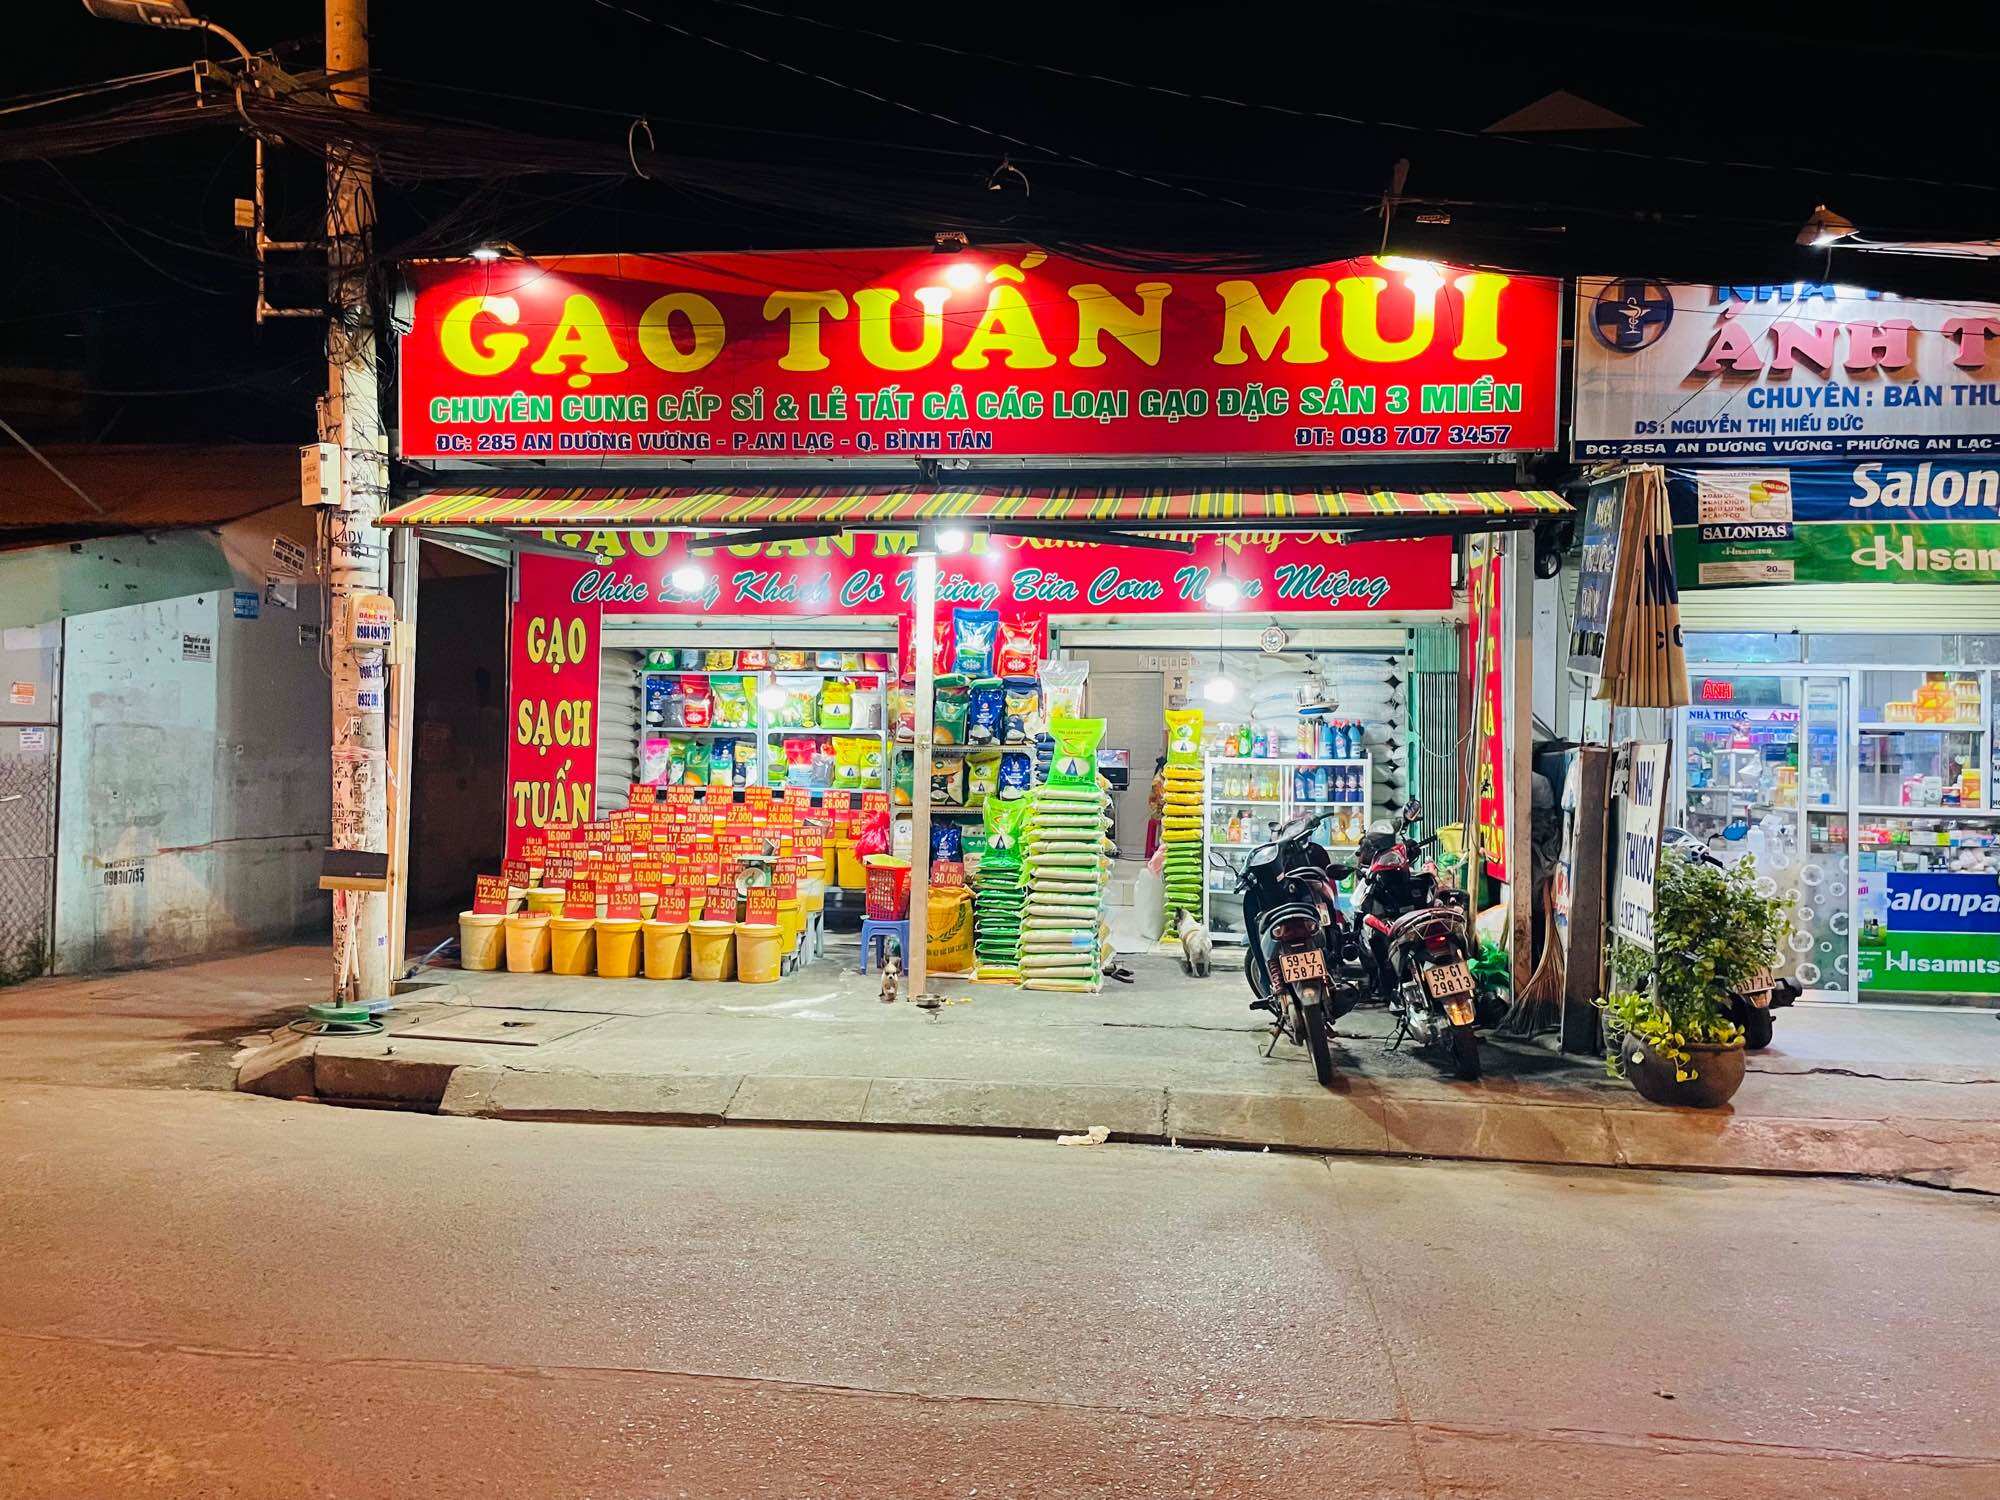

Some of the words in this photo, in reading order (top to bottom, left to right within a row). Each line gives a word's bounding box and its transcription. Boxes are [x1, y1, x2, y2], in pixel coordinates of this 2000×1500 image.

[441, 292, 725, 388] GẠO
[763, 251, 1172, 372] TUẤN
[1698, 301, 1916, 373] ÁNH
[430, 391, 552, 423] CHUYÊN
[562, 395, 648, 421] CUNG
[657, 387, 721, 421] CẤP
[731, 387, 763, 420] SỈ
[773, 394, 799, 420] &
[809, 386, 847, 420] LẺ
[856, 385, 912, 420] TẤT
[923, 385, 968, 419] CẢ
[977, 386, 1043, 419] CÁC
[1053, 389, 1128, 423] LOẠI
[1139, 389, 1208, 422] GẠO
[1217, 383, 1288, 421] ĐẶC
[1300, 379, 1375, 414] SẢN
[1386, 386, 1409, 413] 3
[1421, 375, 1522, 412] MIỀN
[1884, 380, 1942, 406] BÁN
[1671, 413, 1741, 434] NGUYỄN
[1748, 421, 1775, 436] THỊ
[1782, 414, 1821, 432] HIẾU
[1827, 413, 1864, 432] ĐỨC
[436, 434, 471, 450] ĐC:
[478, 434, 515, 450] 285
[523, 434, 552, 450] AN
[560, 430, 631, 450] DƯƠNG
[639, 430, 709, 449] VƯƠNG
[733, 433, 785, 449] P.AN
[793, 433, 833, 453] LẠC
[856, 433, 877, 450] Q.
[886, 430, 937, 449] BÌNH
[947, 428, 992, 449] TÂN
[1295, 428, 1333, 445] ĐT:
[1341, 427, 1386, 444] 098
[1395, 427, 1441, 444] 707
[1448, 425, 1512, 444] 3457
[1586, 444, 1616, 455] ĐC:
[1621, 443, 1666, 454] 285A
[1675, 443, 1698, 453] AN
[1706, 441, 1766, 453] DƯƠNG
[1772, 440, 1832, 452] VƯƠNG
[1846, 437, 1919, 450] PHƯỜNG
[1925, 438, 1950, 449] AN
[1703, 525, 1787, 540] SALONPAS
[1766, 565, 1778, 573] 20
[571, 569, 648, 604] Chúc
[840, 568, 884, 608] Có
[1012, 567, 1079, 602] Bữa
[1087, 566, 1163, 606] Cơm
[1274, 563, 1390, 608] Miệng
[527, 616, 587, 674] GẠO
[1689, 710, 1711, 720] NHÀ
[1714, 710, 1748, 720] THUỐC
[517, 698, 592, 757] SẠCH
[513, 758, 592, 828] TUẤN
[824, 800, 848, 809] 26.000
[728, 811, 752, 822] 27.000
[768, 813, 793, 823] 26.000
[585, 831, 610, 842] 18.000
[626, 830, 651, 841] 17.500
[668, 834, 695, 843] 17.500
[794, 836, 821, 847] 18.000
[522, 845, 546, 857] 13.500
[1626, 818, 1655, 885] THUỐC
[604, 853, 631, 862] 14.000
[692, 853, 718, 863] 16.500
[504, 869, 528, 881] 15.500
[546, 868, 572, 879] 14.500
[634, 871, 661, 882] 16.000
[934, 872, 961, 883] 30.000
[679, 875, 705, 885] 16.000
[478, 886, 507, 900] 12.200
[567, 890, 595, 902] 14.500
[610, 894, 638, 905] 13.500
[708, 896, 737, 910] 14.500
[1286, 952, 1317, 966] 59-L2
[1432, 964, 1462, 981] 59-G1
